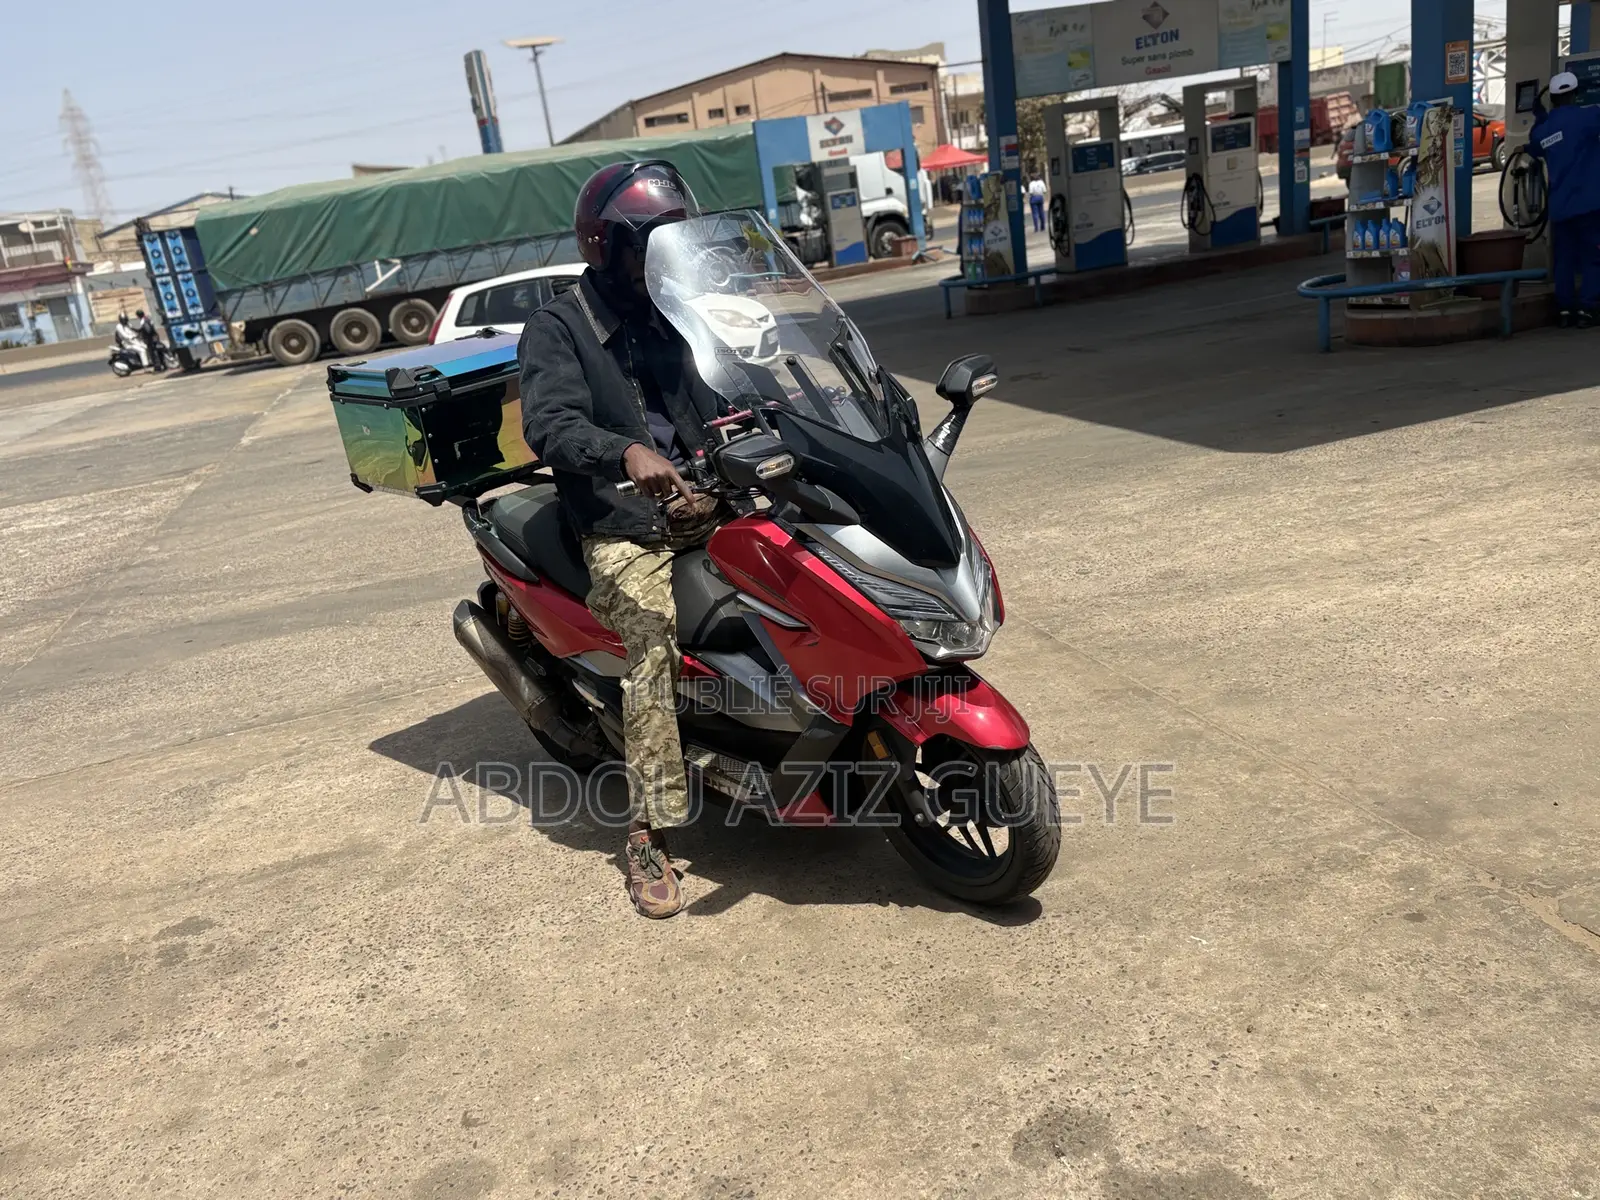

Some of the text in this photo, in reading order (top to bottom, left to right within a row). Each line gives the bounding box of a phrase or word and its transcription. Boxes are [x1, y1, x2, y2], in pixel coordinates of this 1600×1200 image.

[1135, 28, 1180, 50] ELTON
[1121, 48, 1195, 66] Super sans plomb
[1145, 64, 1171, 75] Gasoil
